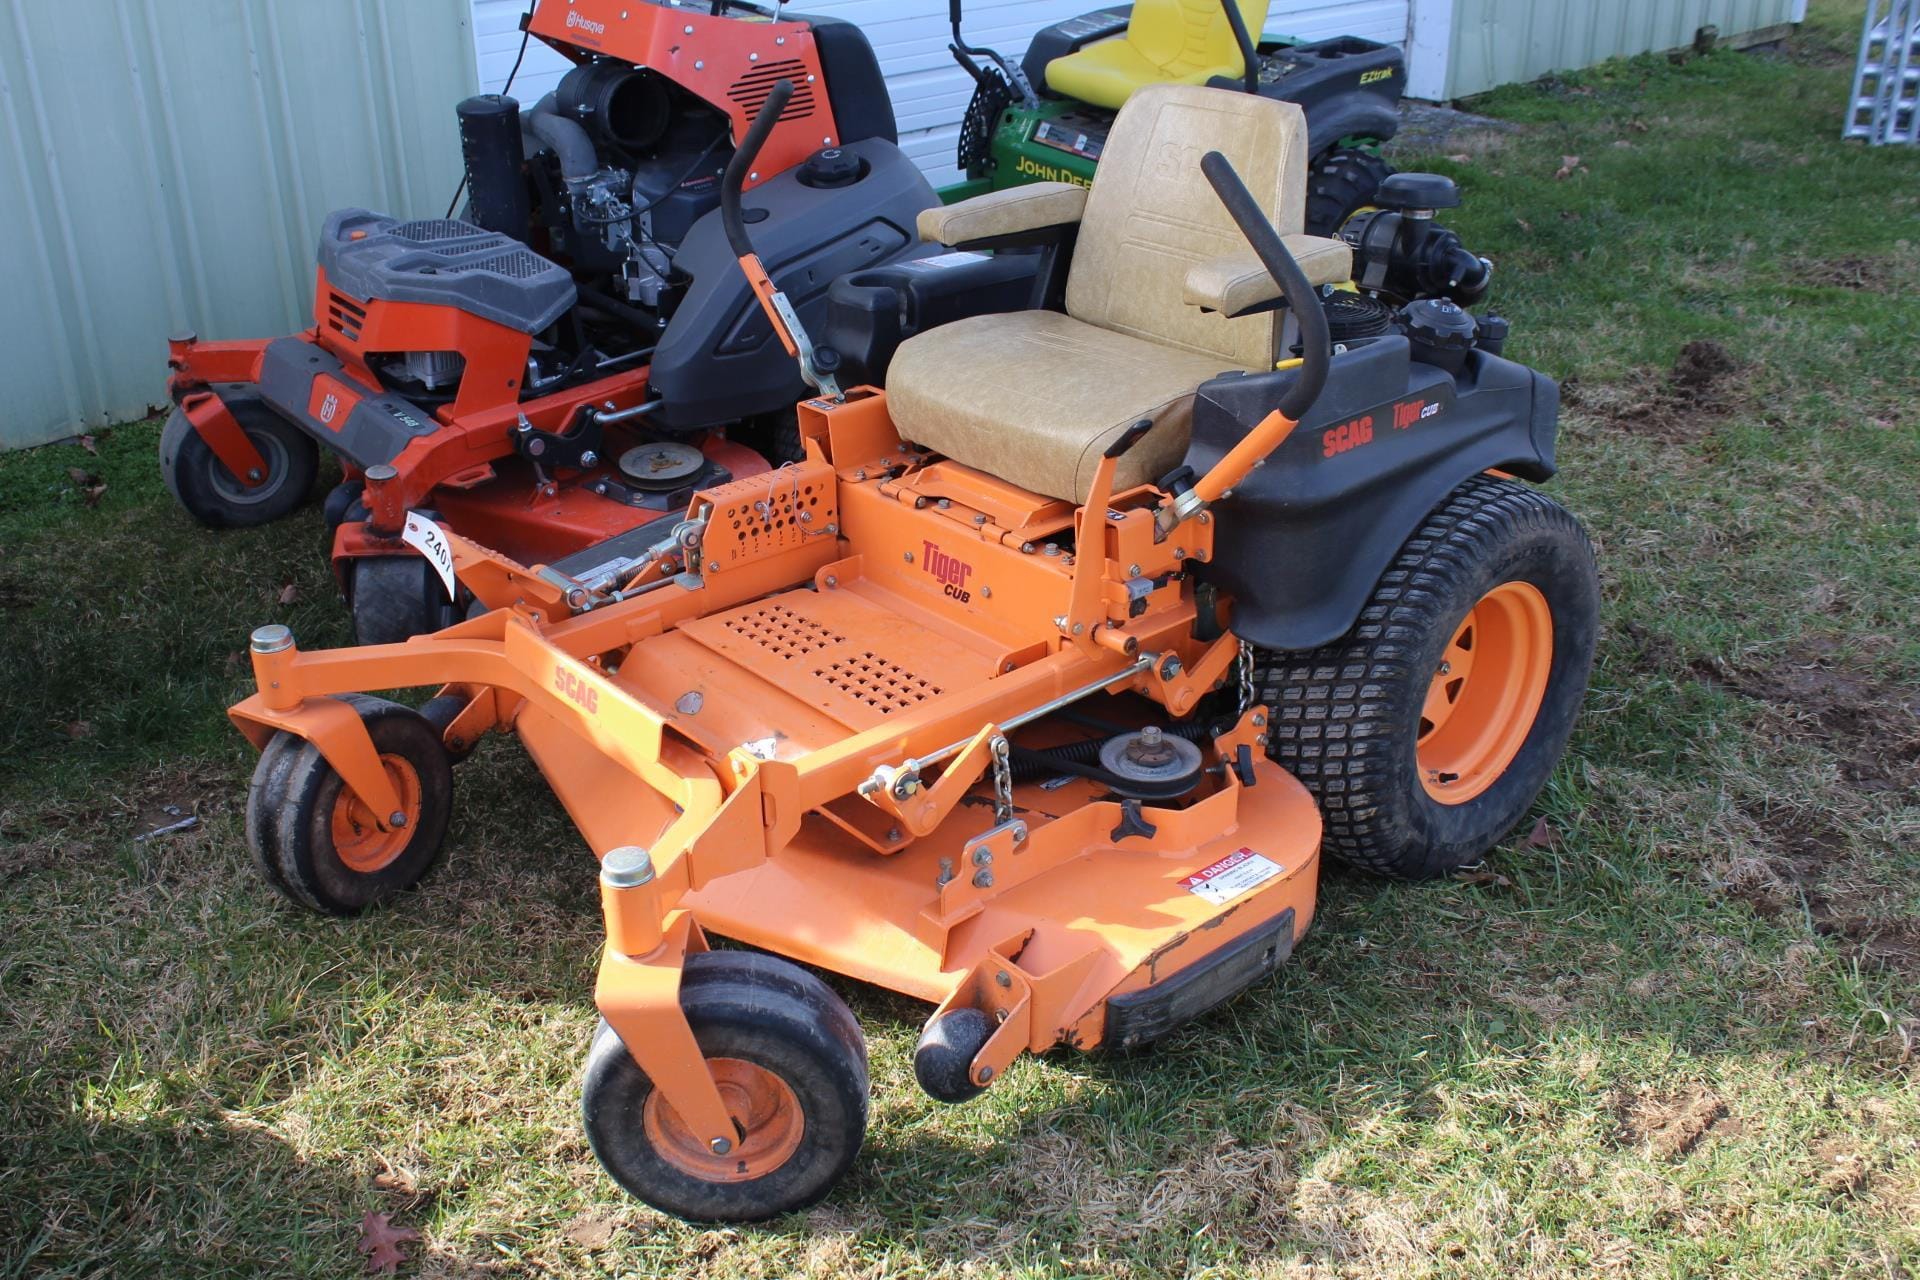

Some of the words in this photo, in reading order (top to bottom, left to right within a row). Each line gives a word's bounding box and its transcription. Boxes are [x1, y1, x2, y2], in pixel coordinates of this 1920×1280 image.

[1016, 155, 1057, 182] JOHN
[1061, 169, 1094, 191] DEE
[1323, 415, 1373, 458] SCAG
[1393, 399, 1424, 429] Tiger
[1421, 402, 1439, 419] CUB
[425, 530, 451, 573] 2407
[923, 539, 972, 588] Tiger
[944, 584, 971, 604] CUB
[555, 665, 598, 714] SCAG
[1201, 852, 1249, 878] DANGER
